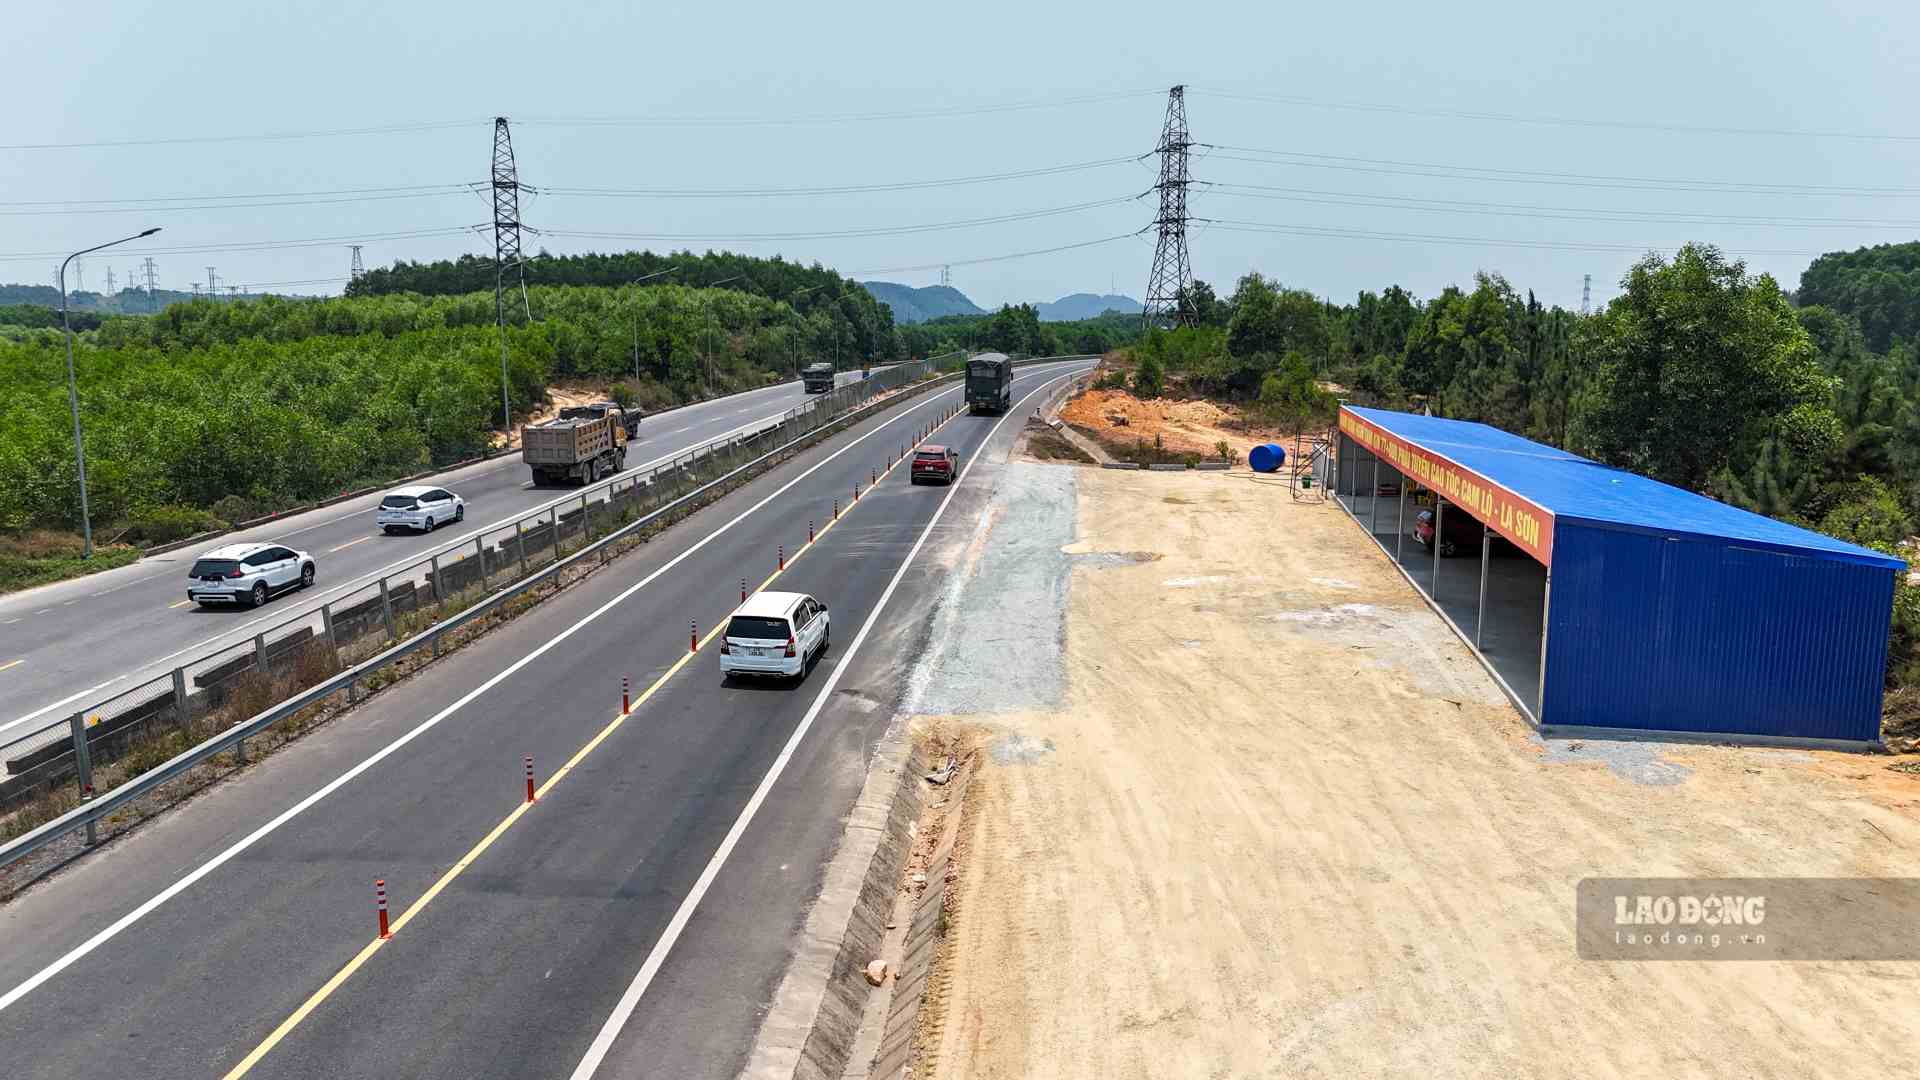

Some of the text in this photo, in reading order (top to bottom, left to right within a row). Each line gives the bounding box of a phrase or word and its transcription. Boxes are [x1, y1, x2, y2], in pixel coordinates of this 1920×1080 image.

[1445, 466, 1460, 497] TỐC
[1461, 479, 1481, 513] CAM
[1481, 489, 1493, 523] LỘ
[1501, 502, 1513, 529] LA
[1515, 510, 1540, 548] SƠN
